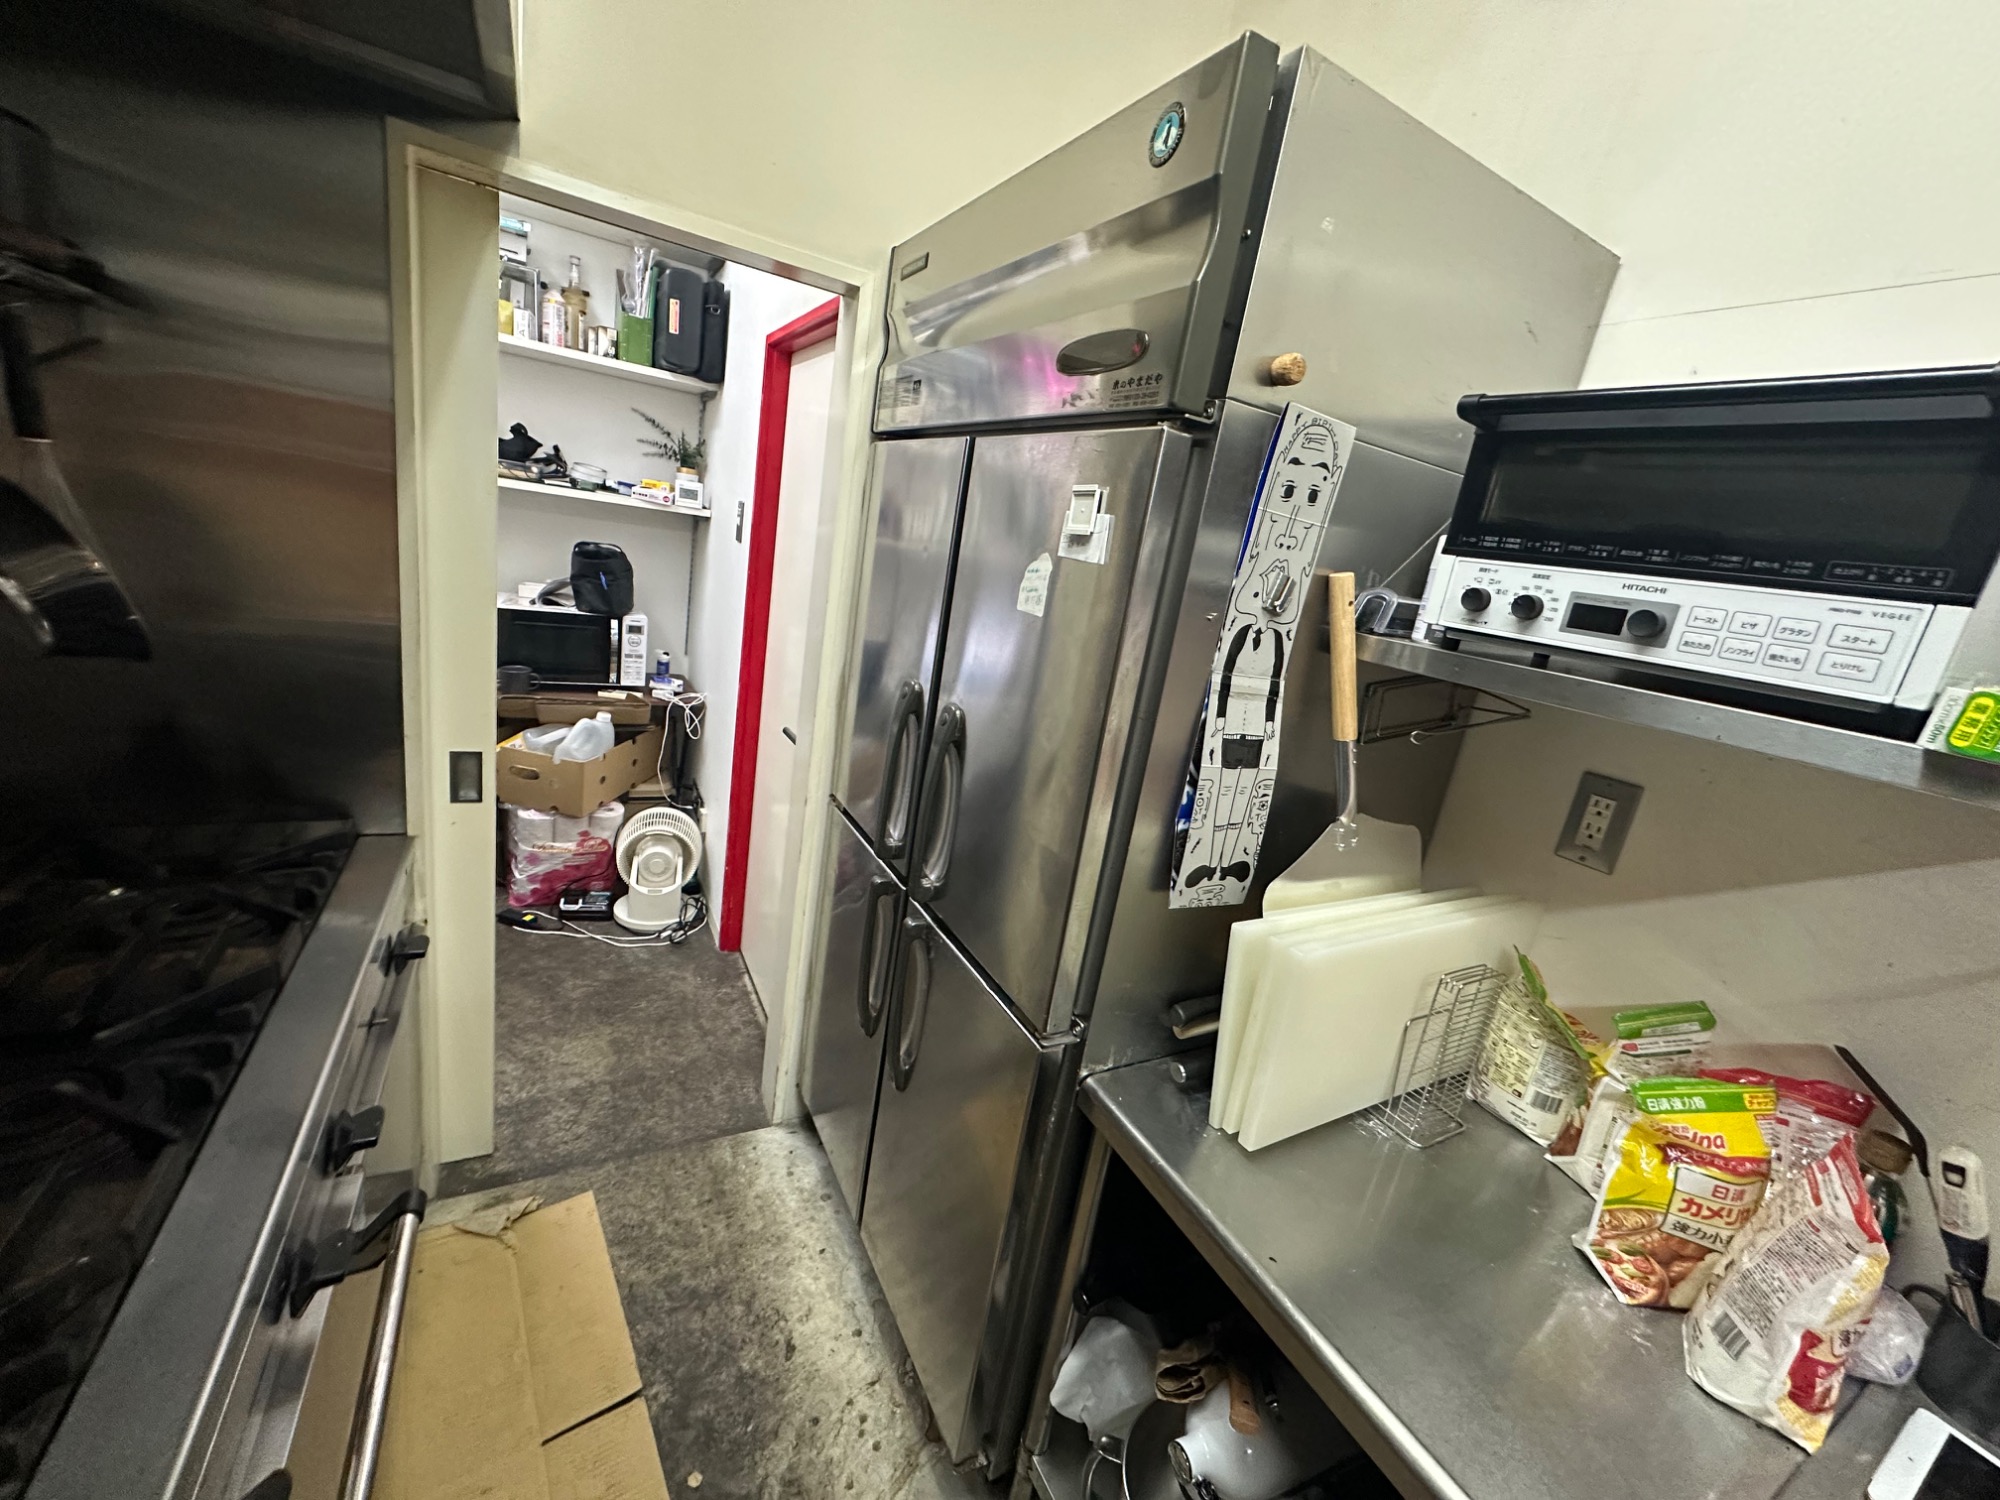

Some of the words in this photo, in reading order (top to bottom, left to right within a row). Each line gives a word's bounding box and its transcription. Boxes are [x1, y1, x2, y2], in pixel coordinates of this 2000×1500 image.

[1622, 583, 1667, 595] HITACHI
[1693, 615, 1719, 624] トースト
[1779, 627, 1812, 637] グラタン
[1840, 635, 1876, 646] スタート
[1830, 661, 1865, 673] とりけし
